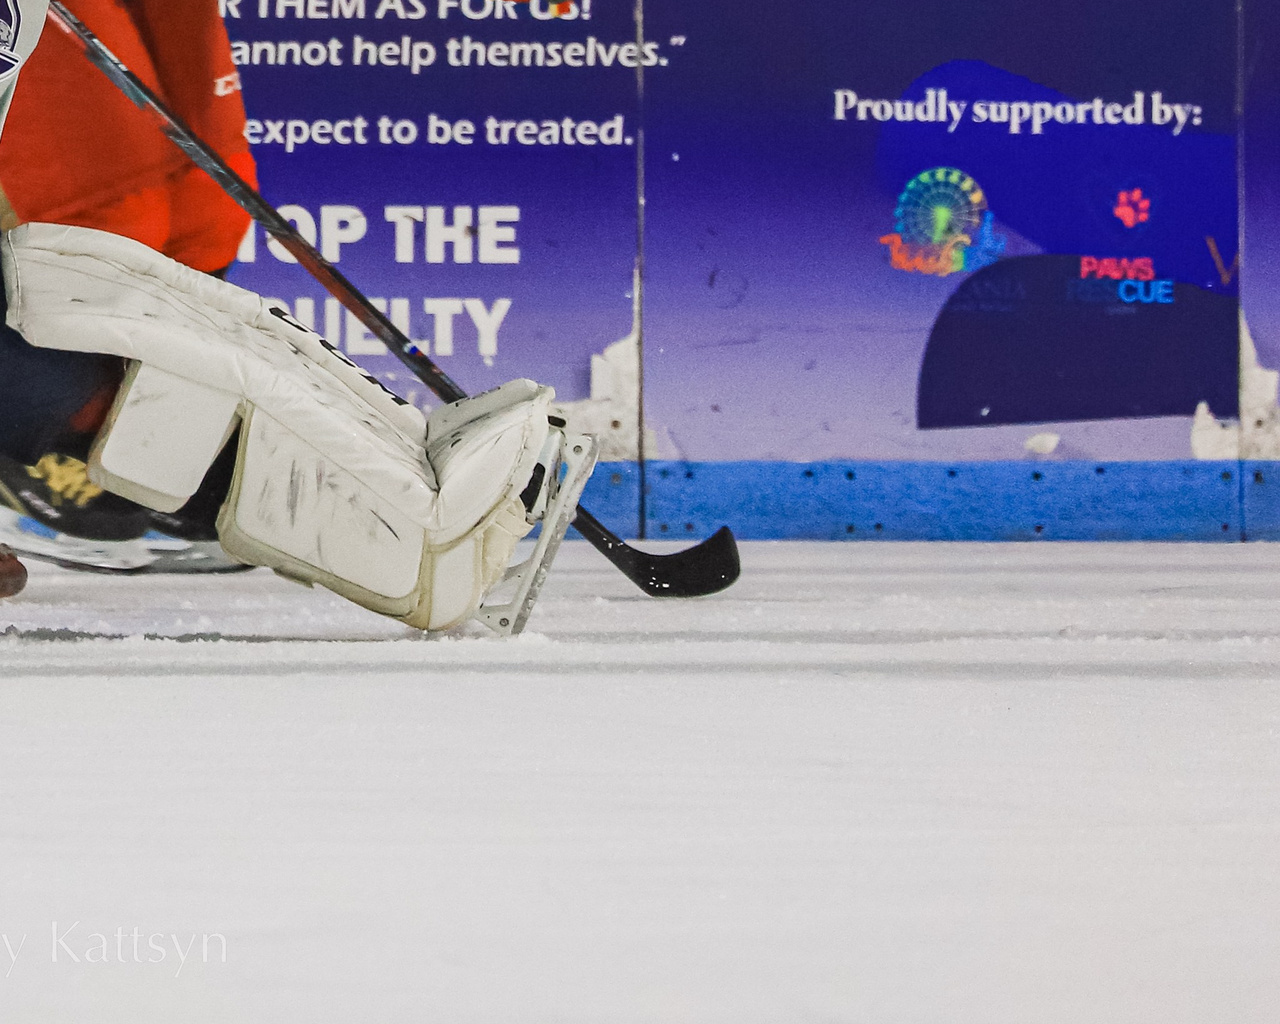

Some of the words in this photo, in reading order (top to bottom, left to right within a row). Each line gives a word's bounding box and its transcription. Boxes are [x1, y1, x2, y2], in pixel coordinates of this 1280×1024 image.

[231, 38, 343, 66] annot
[353, 35, 436, 75] help
[244, 116, 367, 153] expect
[378, 116, 417, 145] to
[427, 114, 475, 146] be
[486, 115, 634, 146] treated.
[834, 87, 967, 133] Proudly
[972, 91, 1144, 135] supported
[1151, 91, 1202, 136] by:
[236, 204, 368, 264] OP
[384, 205, 521, 264] THE
[261, 297, 513, 357] UELTY
